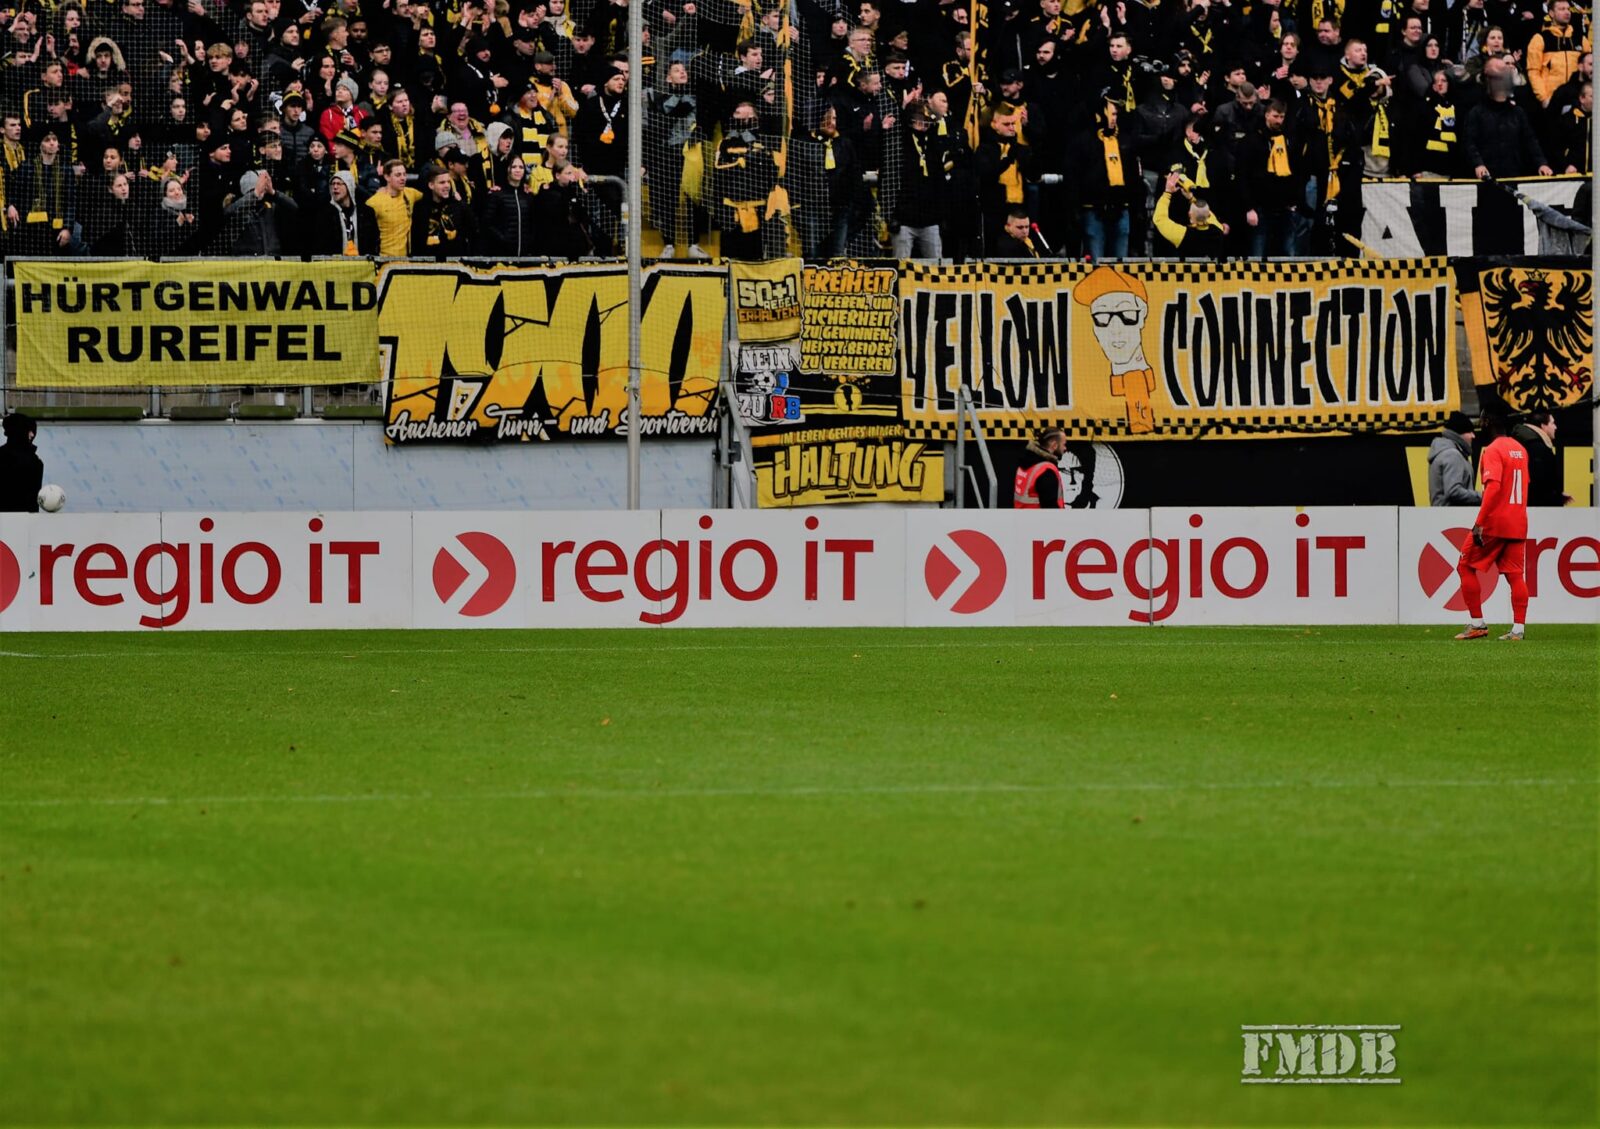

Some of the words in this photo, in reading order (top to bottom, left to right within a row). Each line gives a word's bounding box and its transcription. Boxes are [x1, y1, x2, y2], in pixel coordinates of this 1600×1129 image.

[738, 276, 796, 308] 50+1
[804, 267, 893, 293] FREIHEIT
[22, 277, 377, 313] HÜRTGENWALD
[763, 296, 799, 311] REGEL
[872, 296, 893, 311] UM
[802, 325, 820, 339] ZU
[803, 309, 893, 327] SICHERHEIT
[68, 325, 342, 363] RUREIFEL
[847, 341, 893, 356] BEIDES
[903, 291, 1070, 410] YELLOW
[1163, 286, 1448, 407] CONNECTION
[741, 348, 791, 371] NEIN
[801, 355, 820, 370] ZU
[823, 355, 893, 371] VERLIEREN
[738, 395, 765, 417] ZU
[771, 395, 800, 419] RB
[386, 411, 477, 442] Aachener
[486, 404, 557, 439] Turn-
[571, 409, 609, 435] und
[796, 428, 827, 443] LEBEN
[829, 425, 854, 440] GEHT
[855, 425, 866, 438] ES
[773, 441, 927, 495] HALTUNG
[1509, 469, 1522, 504] 11
[39, 517, 282, 629] regio
[541, 515, 778, 624] regio
[1032, 513, 1268, 623] regio
